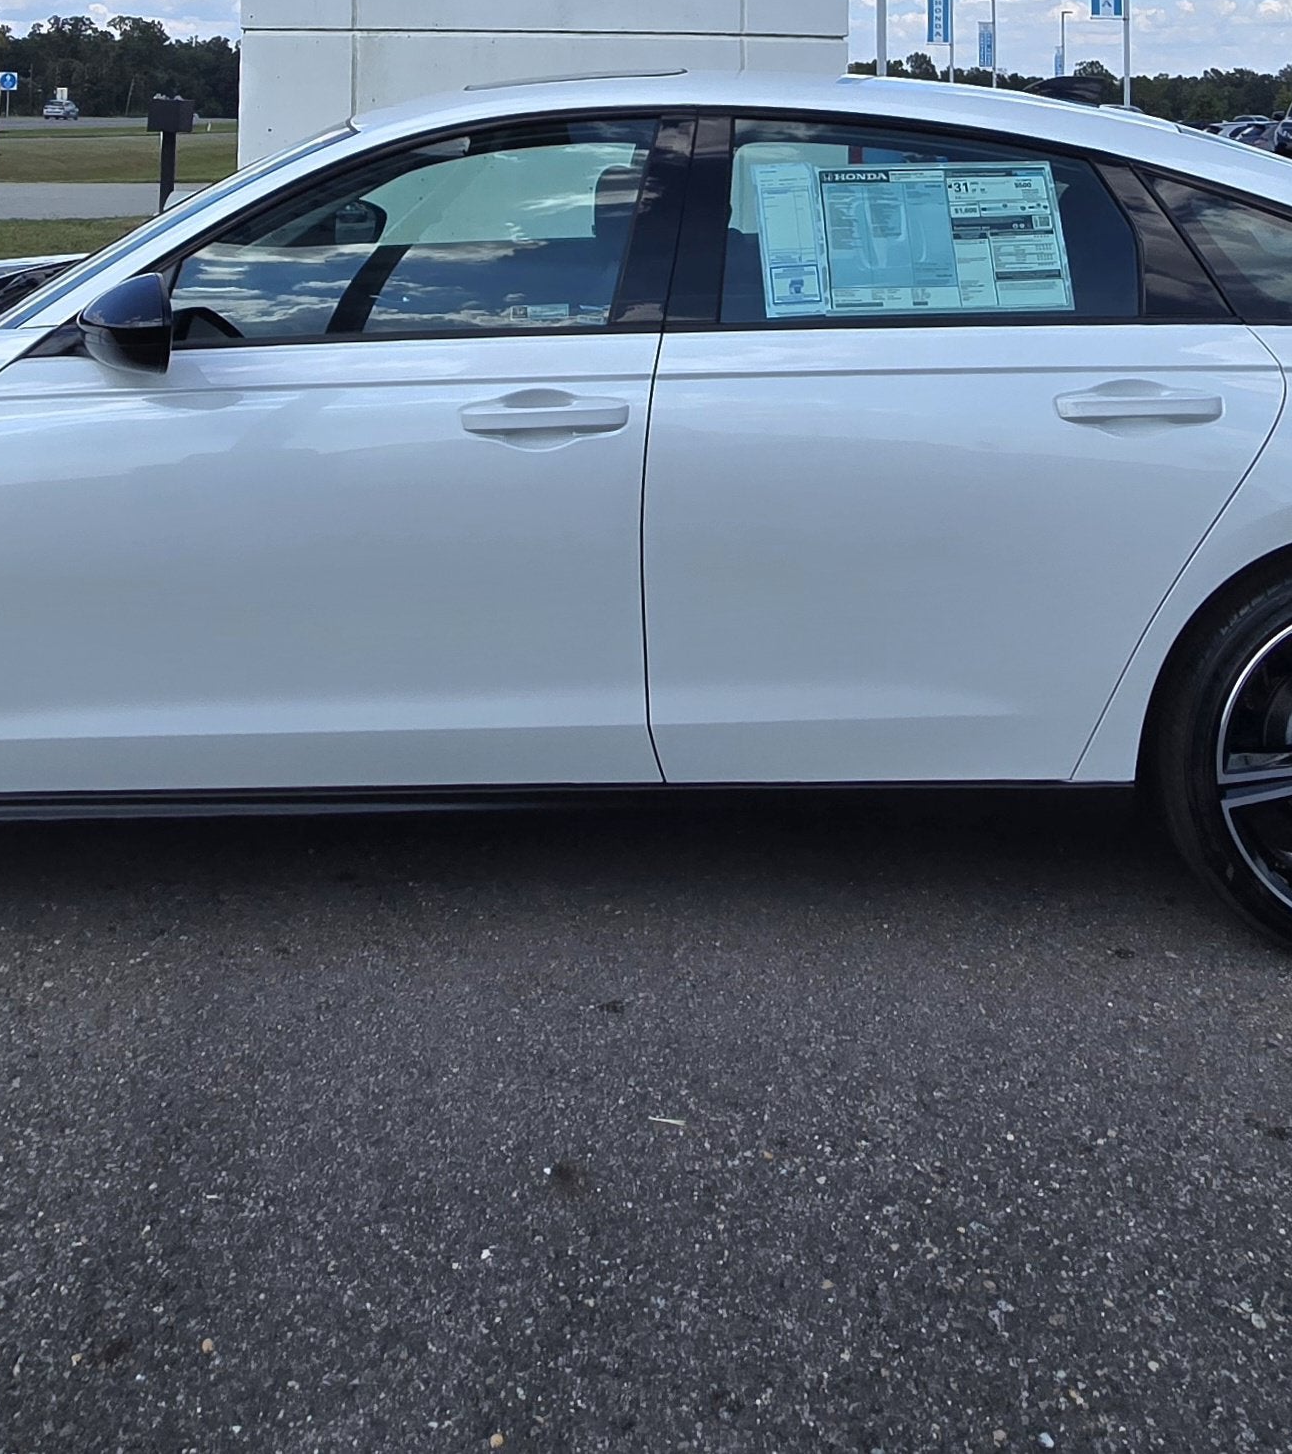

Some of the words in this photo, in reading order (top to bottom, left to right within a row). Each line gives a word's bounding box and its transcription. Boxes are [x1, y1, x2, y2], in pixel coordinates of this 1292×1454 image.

[934, 0, 943, 38] HONDA
[834, 172, 888, 182] HONDA
[953, 182, 969, 194] 31
